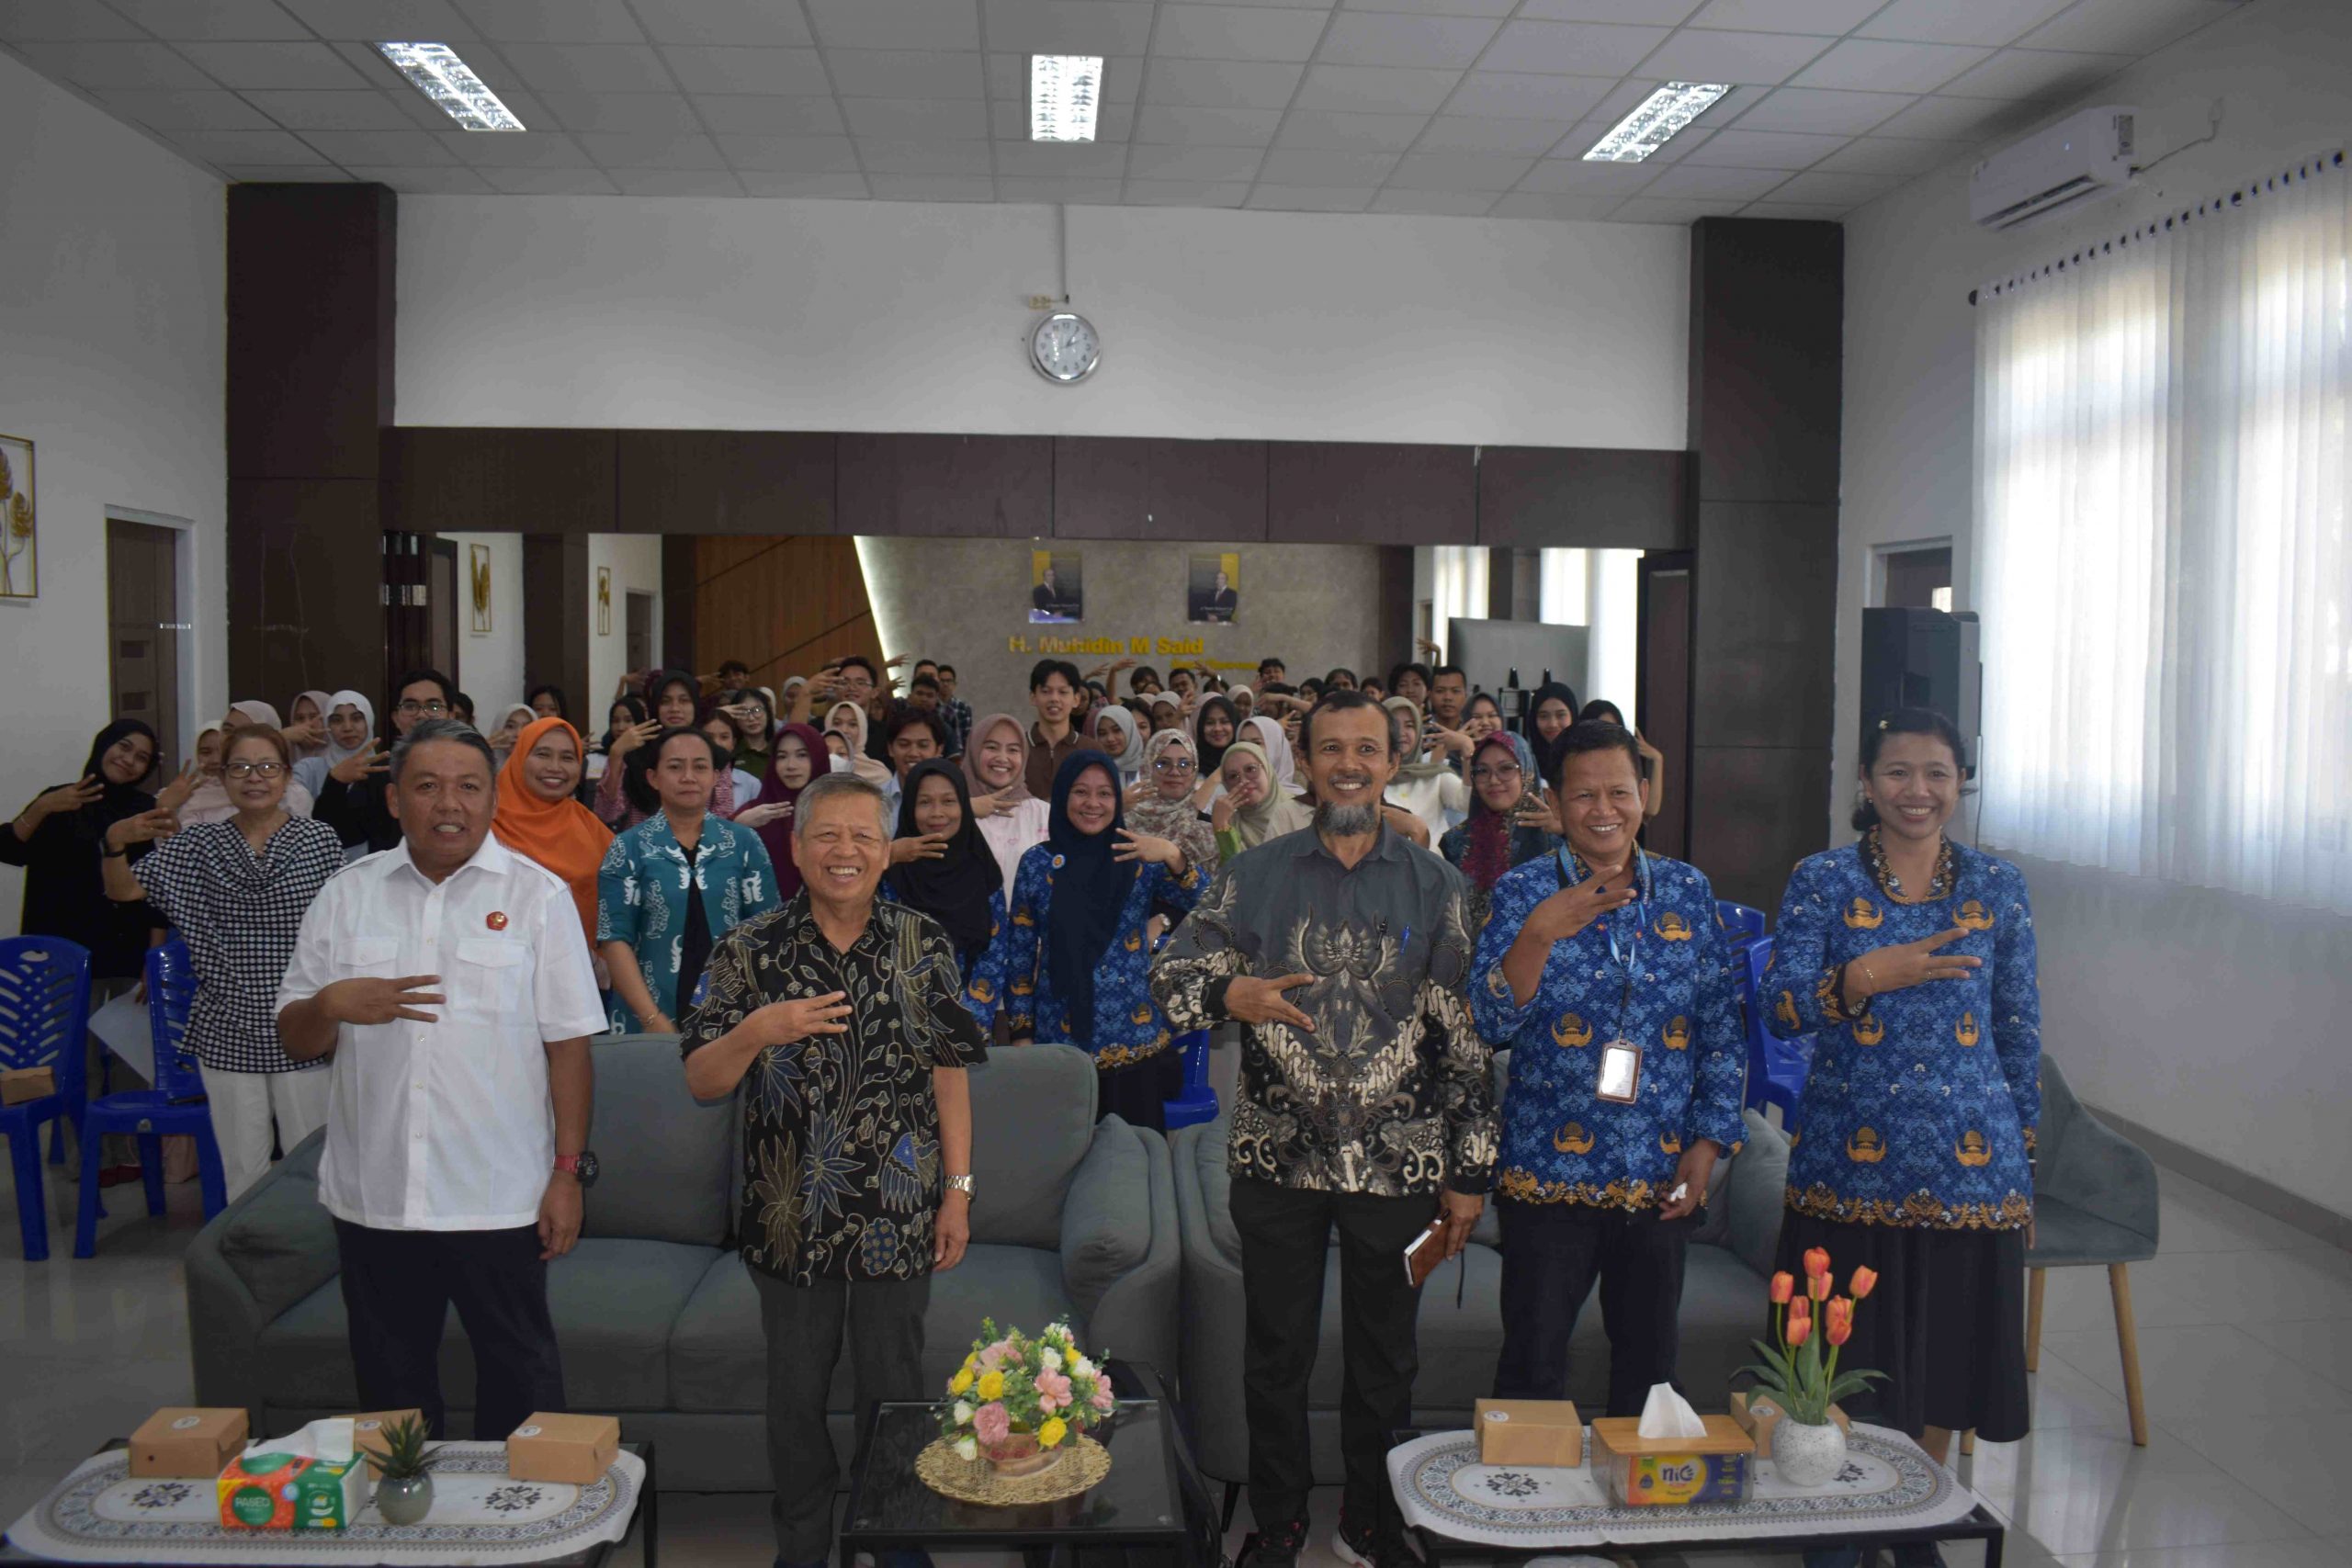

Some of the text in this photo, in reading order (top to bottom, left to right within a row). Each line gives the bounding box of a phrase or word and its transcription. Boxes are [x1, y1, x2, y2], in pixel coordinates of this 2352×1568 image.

[1008, 636, 1204, 655] H. Muhidin M Said
